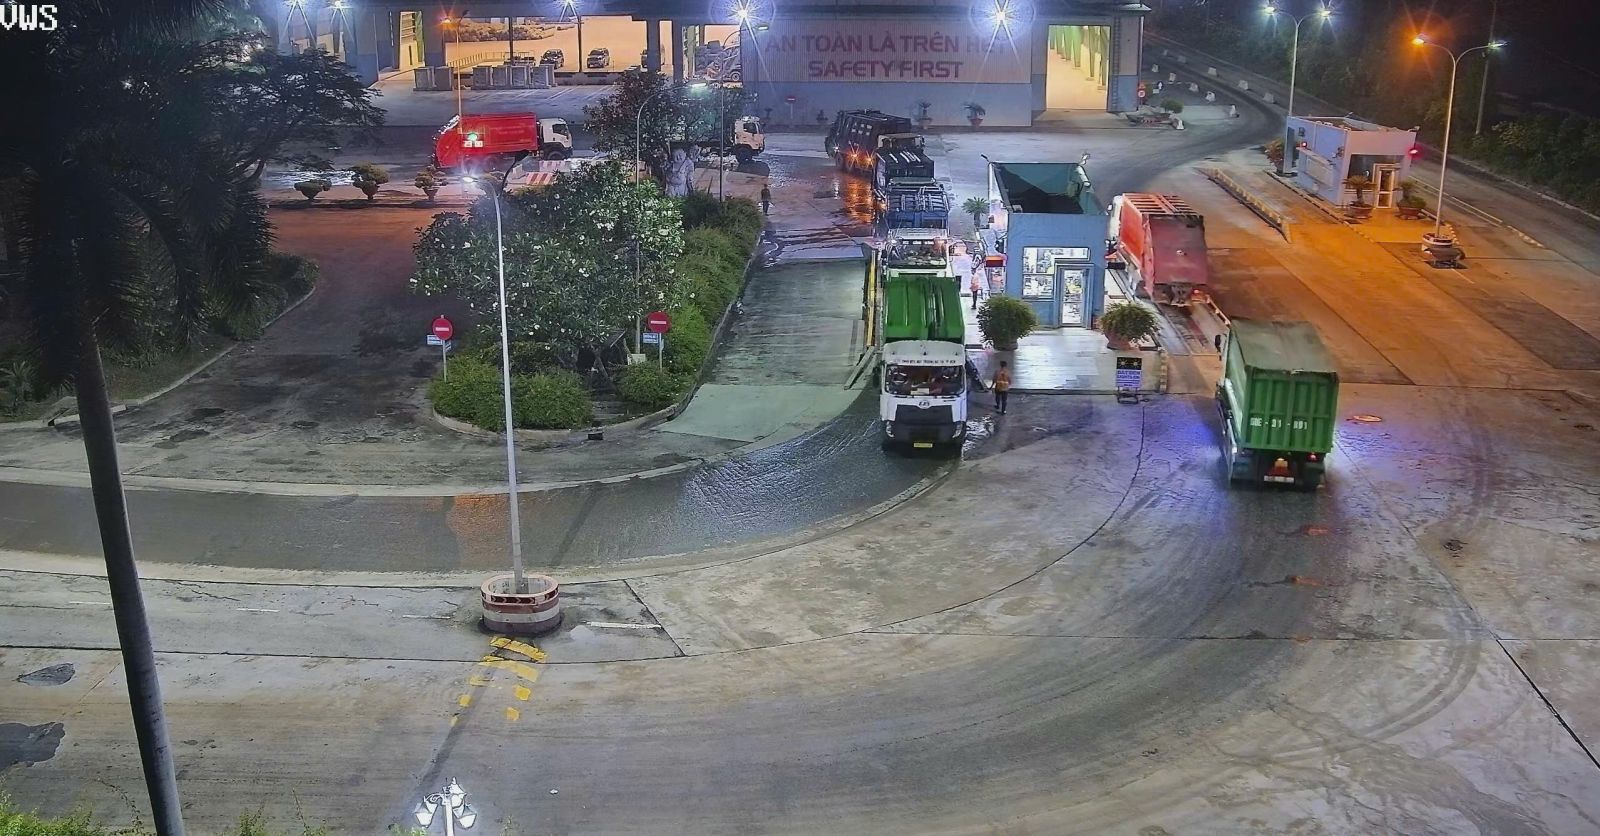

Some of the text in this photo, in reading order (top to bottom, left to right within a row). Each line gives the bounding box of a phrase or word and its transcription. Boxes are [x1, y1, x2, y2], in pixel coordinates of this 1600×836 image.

[765, 35, 797, 52] AN
[801, 31, 863, 52] TOÀN
[870, 30, 896, 52] LÀ
[900, 31, 959, 52] TRÊN
[808, 60, 964, 78] SAFETY FIRST
